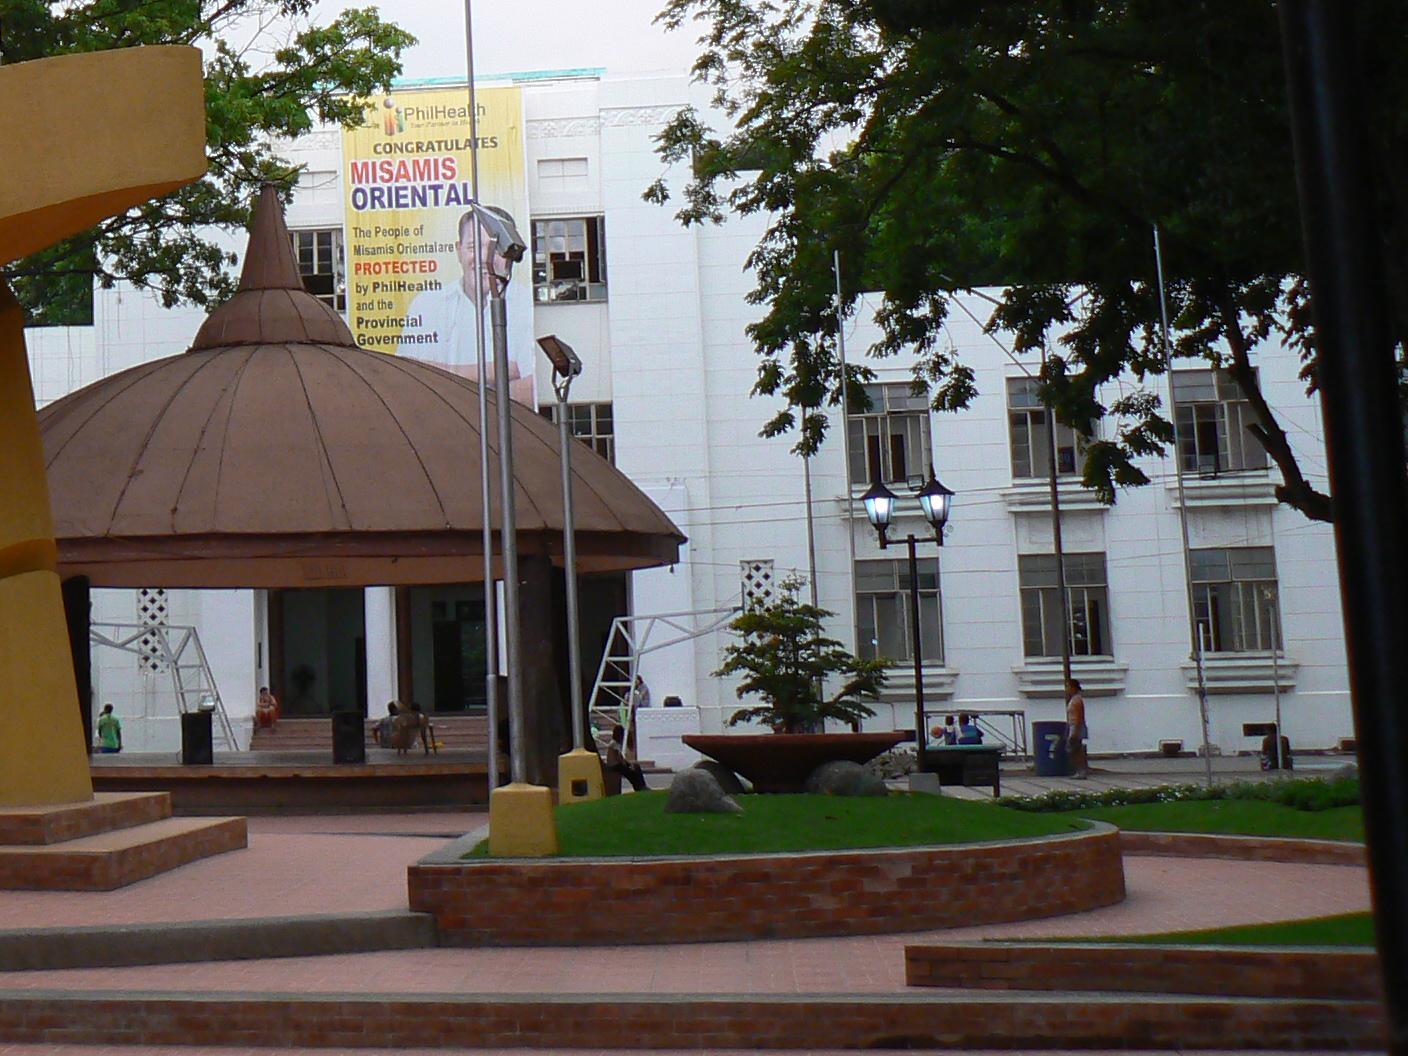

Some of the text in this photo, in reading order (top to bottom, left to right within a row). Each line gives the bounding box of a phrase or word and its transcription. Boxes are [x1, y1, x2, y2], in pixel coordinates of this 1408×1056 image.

[350, 157, 457, 185] MISAMIS
[351, 182, 474, 211] ORIENTAL
[353, 224, 424, 239] The People of
[353, 244, 394, 256] Misamis
[354, 260, 438, 275] PROTECTED
[355, 280, 442, 296] by PhilHealth
[356, 299, 393, 311] and the
[356, 315, 423, 329] Provincial
[357, 331, 439, 346] Government
[1044, 733, 1061, 760] 7
